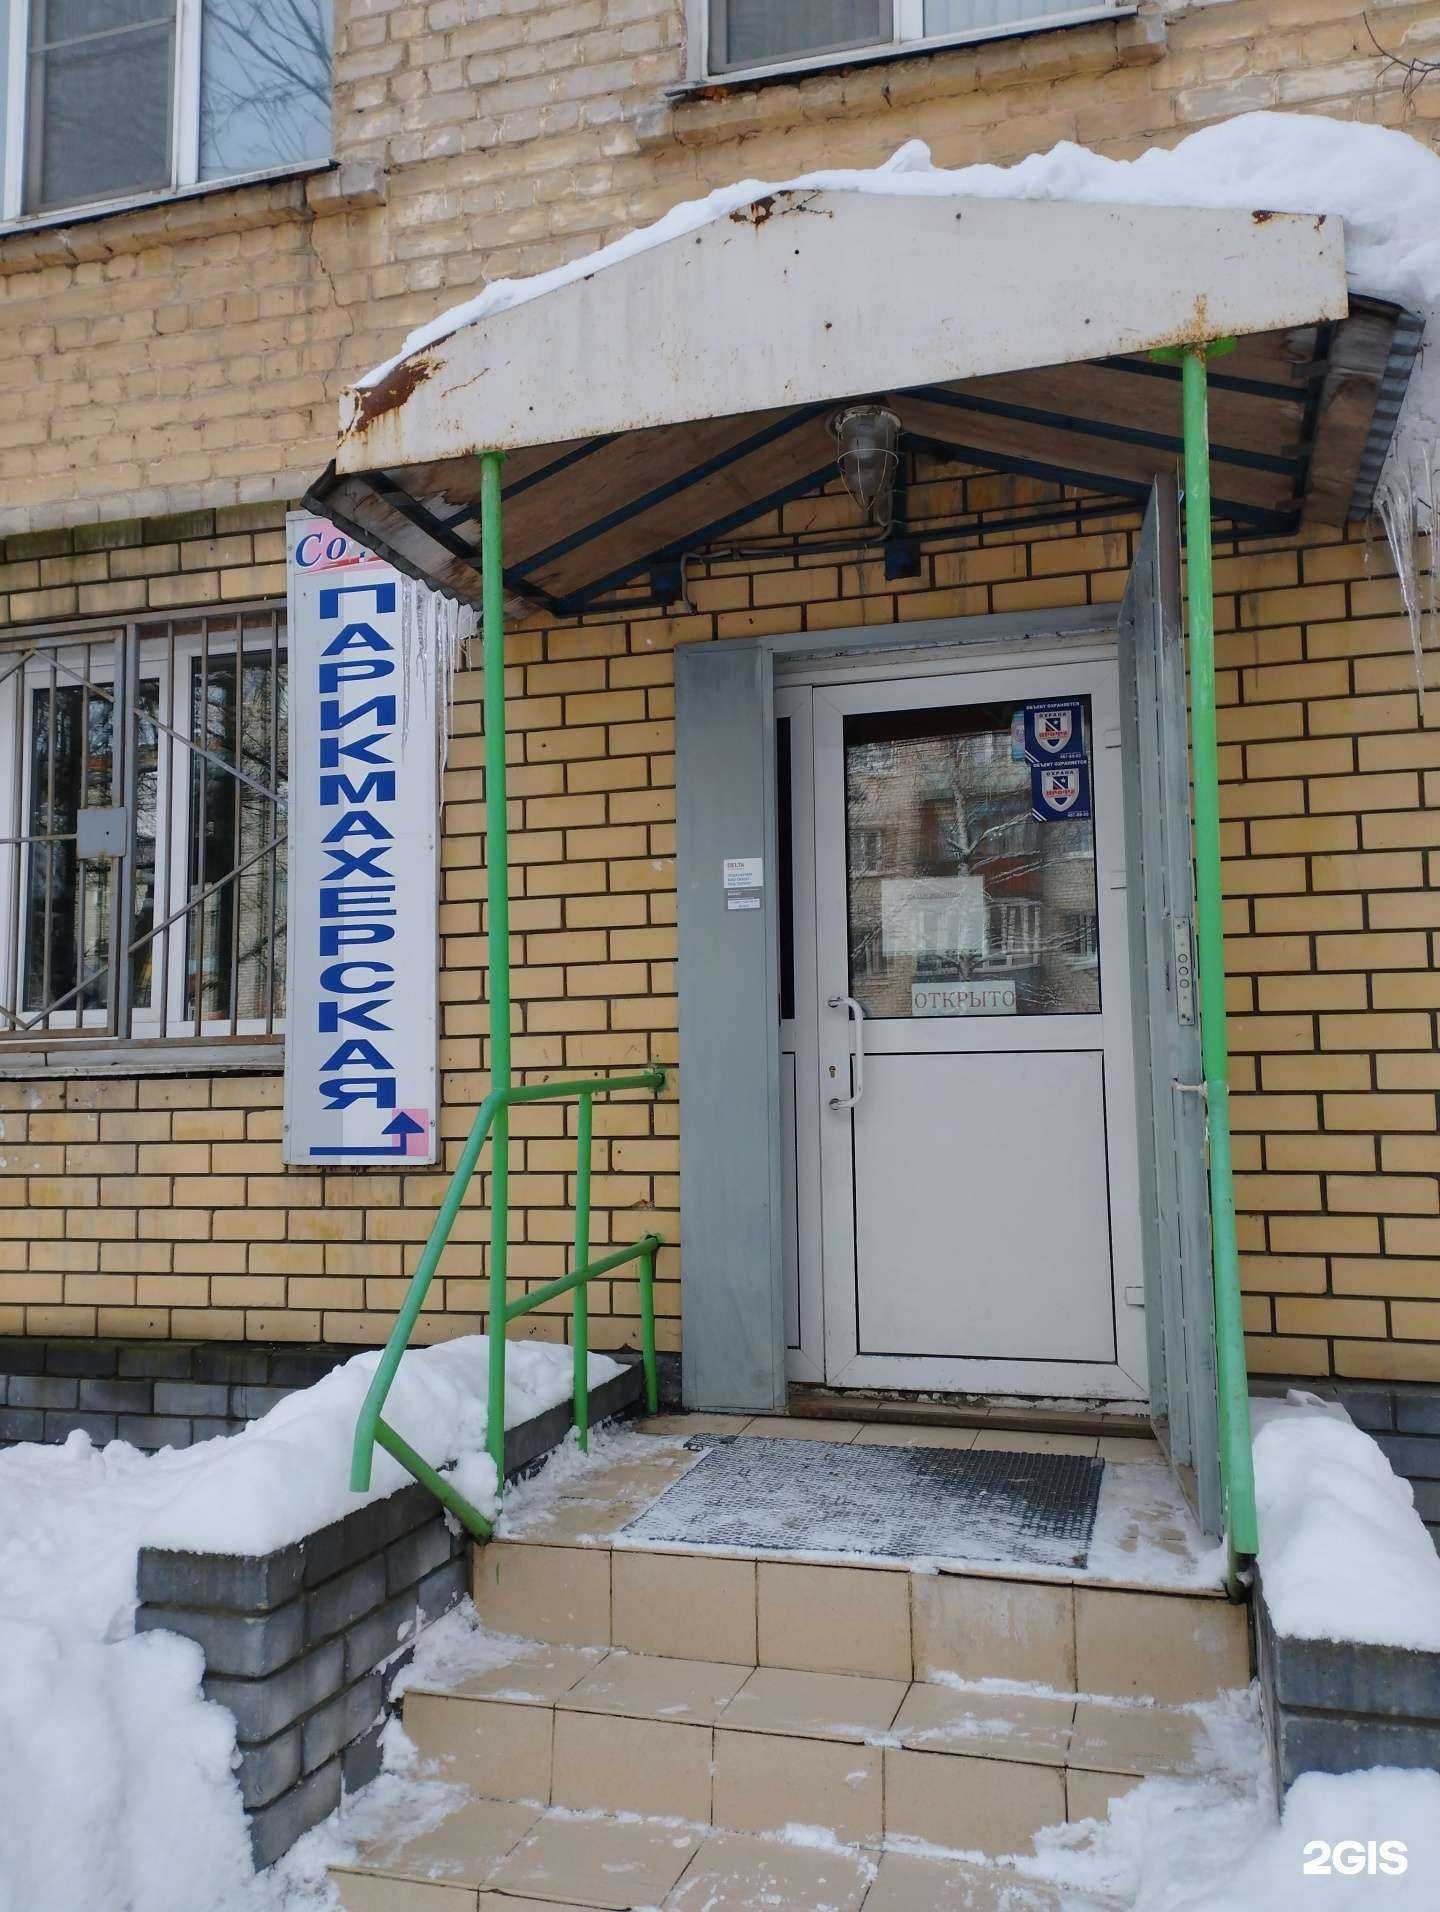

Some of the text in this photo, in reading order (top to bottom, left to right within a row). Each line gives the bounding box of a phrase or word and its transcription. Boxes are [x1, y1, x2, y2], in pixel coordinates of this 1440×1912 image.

[1046, 769, 1074, 777] ОХРАНА
[318, 581, 397, 1110] ПАРИКМАХЕРСКАЯ
[914, 990, 1016, 1009] ОТКРЫТО
